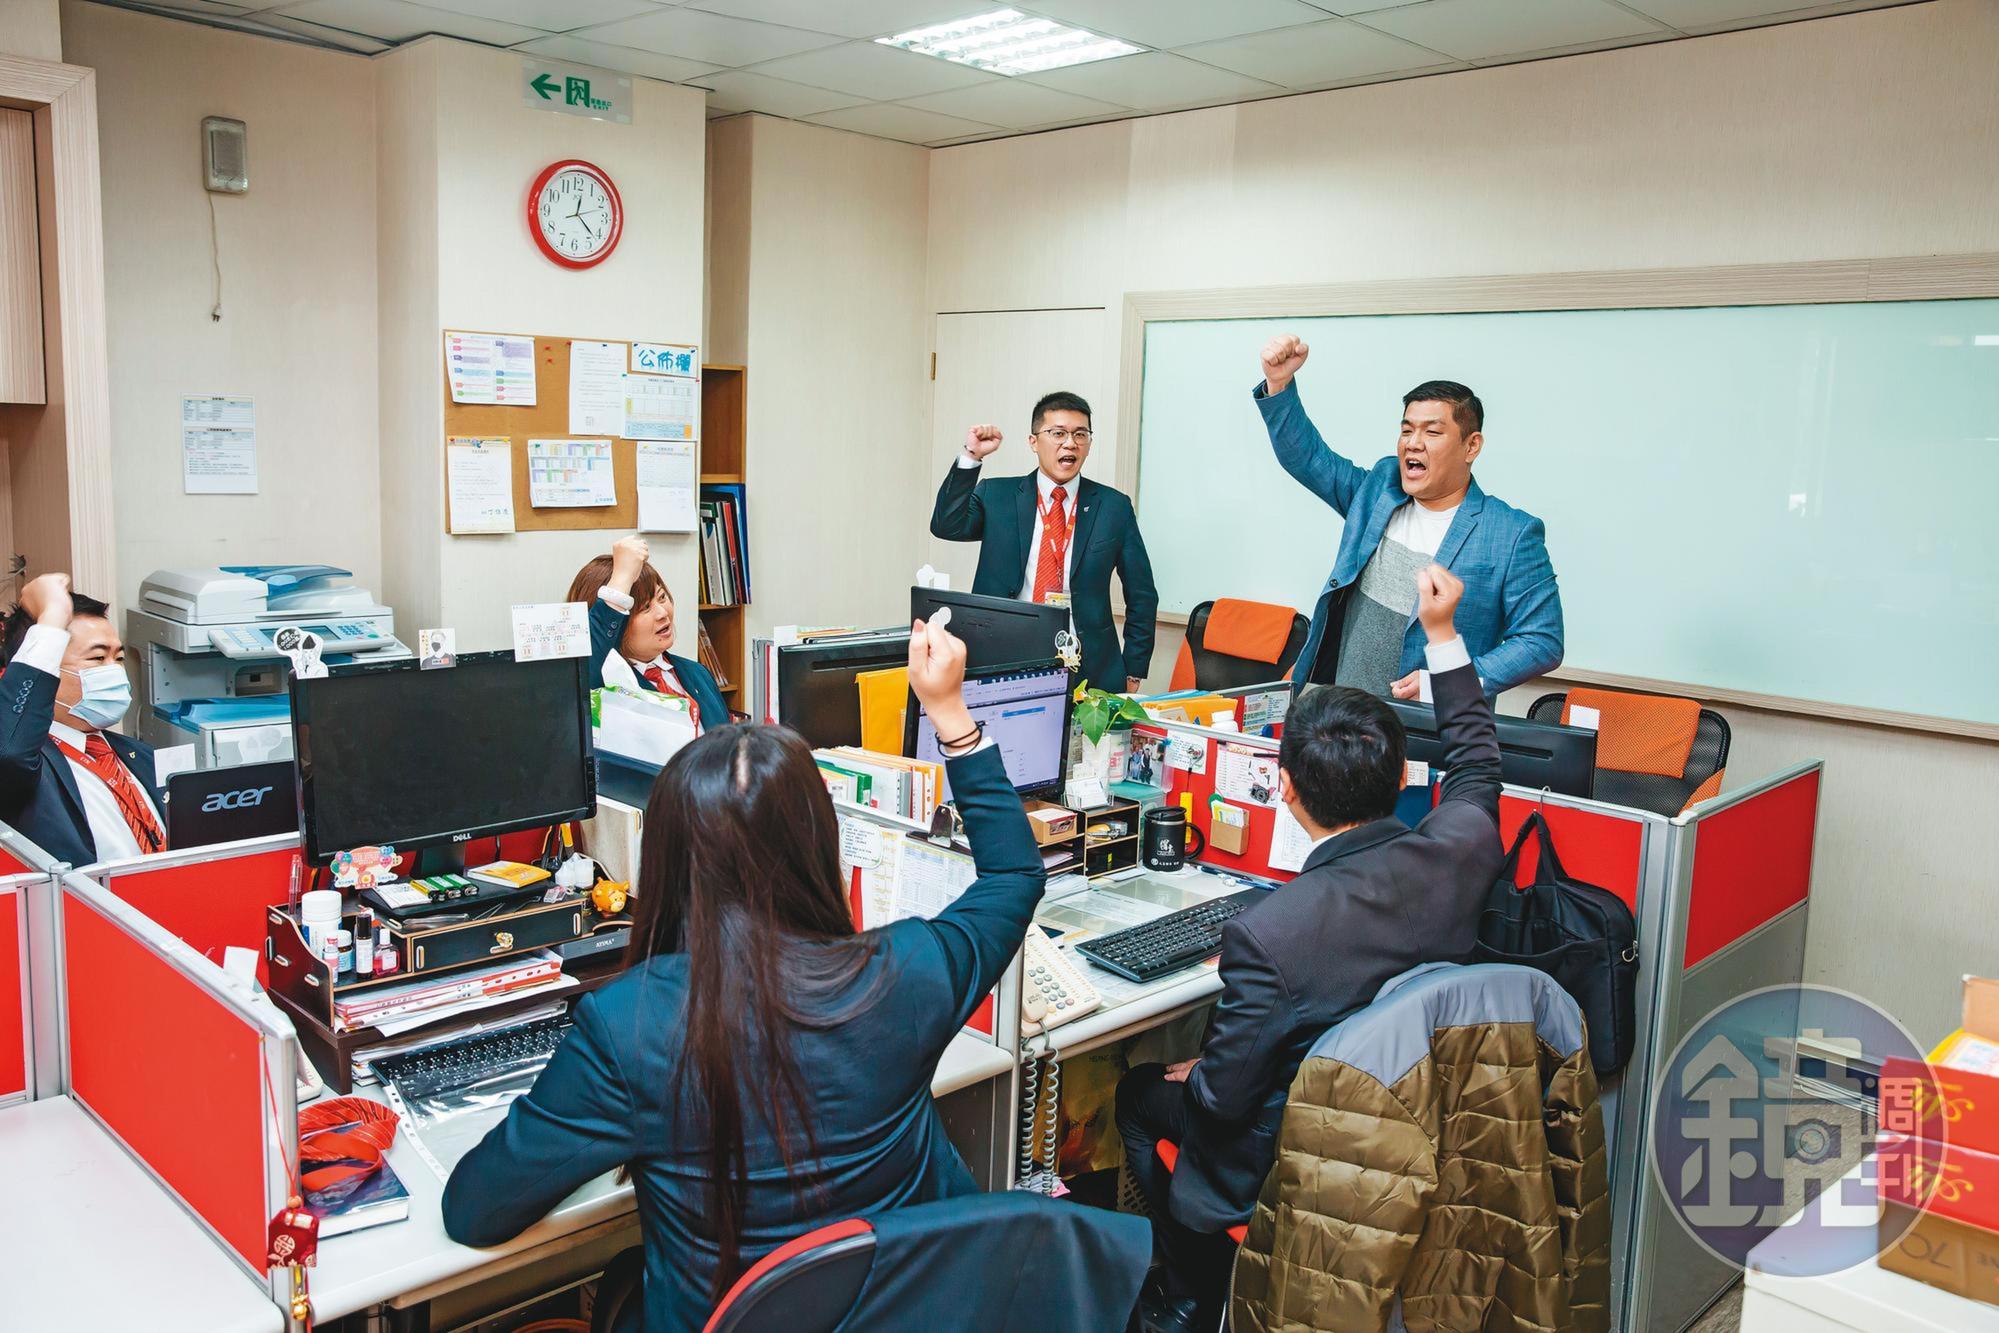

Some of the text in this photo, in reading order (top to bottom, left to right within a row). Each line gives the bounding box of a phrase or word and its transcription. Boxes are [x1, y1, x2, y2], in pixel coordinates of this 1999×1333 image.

[561, 179, 570, 194] 11
[573, 176, 584, 192] 12
[549, 188, 560, 203] 10
[597, 194, 605, 209] 2
[543, 203, 551, 217] 9
[600, 212, 608, 225] 3
[547, 220, 556, 234] 8
[595, 226, 602, 240] 4
[559, 232, 566, 247] 7
[570, 238, 578, 252] 6
[584, 236, 592, 250] 5
[201, 786, 273, 813] acer
[452, 832, 472, 842] DELL
